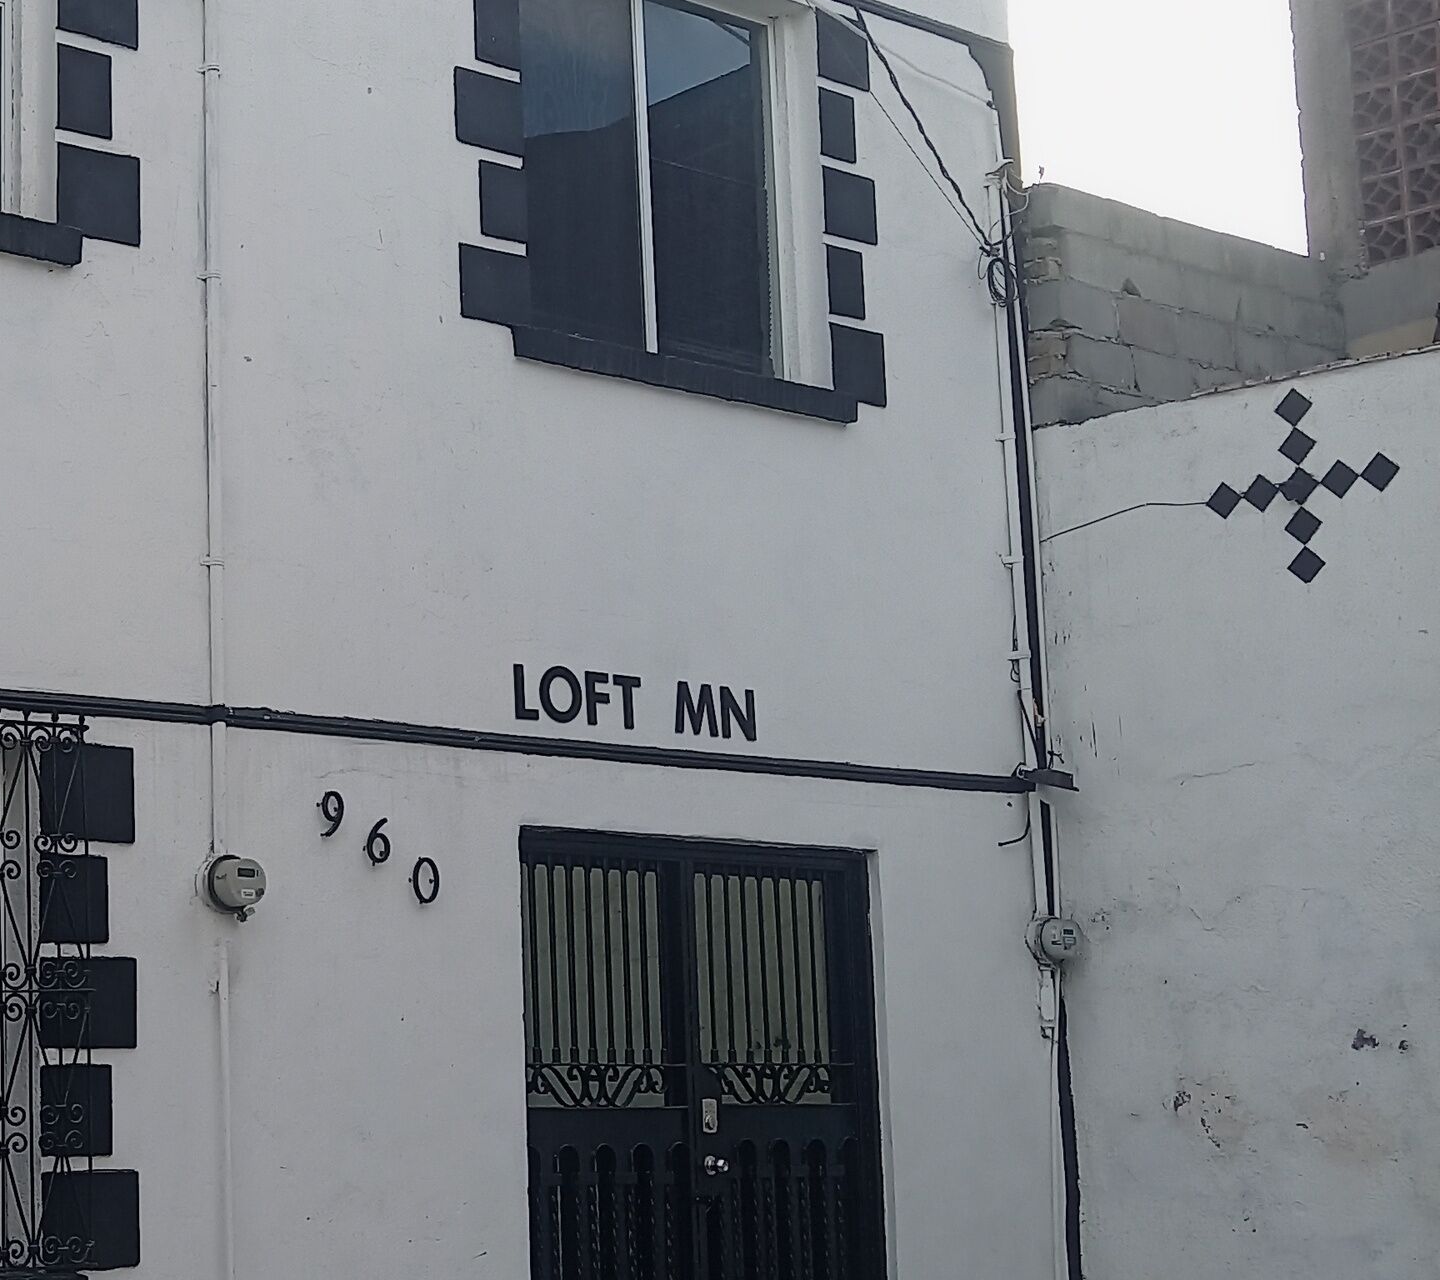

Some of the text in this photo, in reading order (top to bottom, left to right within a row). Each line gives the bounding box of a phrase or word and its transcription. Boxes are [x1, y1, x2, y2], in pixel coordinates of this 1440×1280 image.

[513, 664, 757, 741] LOFT MN
[317, 791, 440, 904] 960
